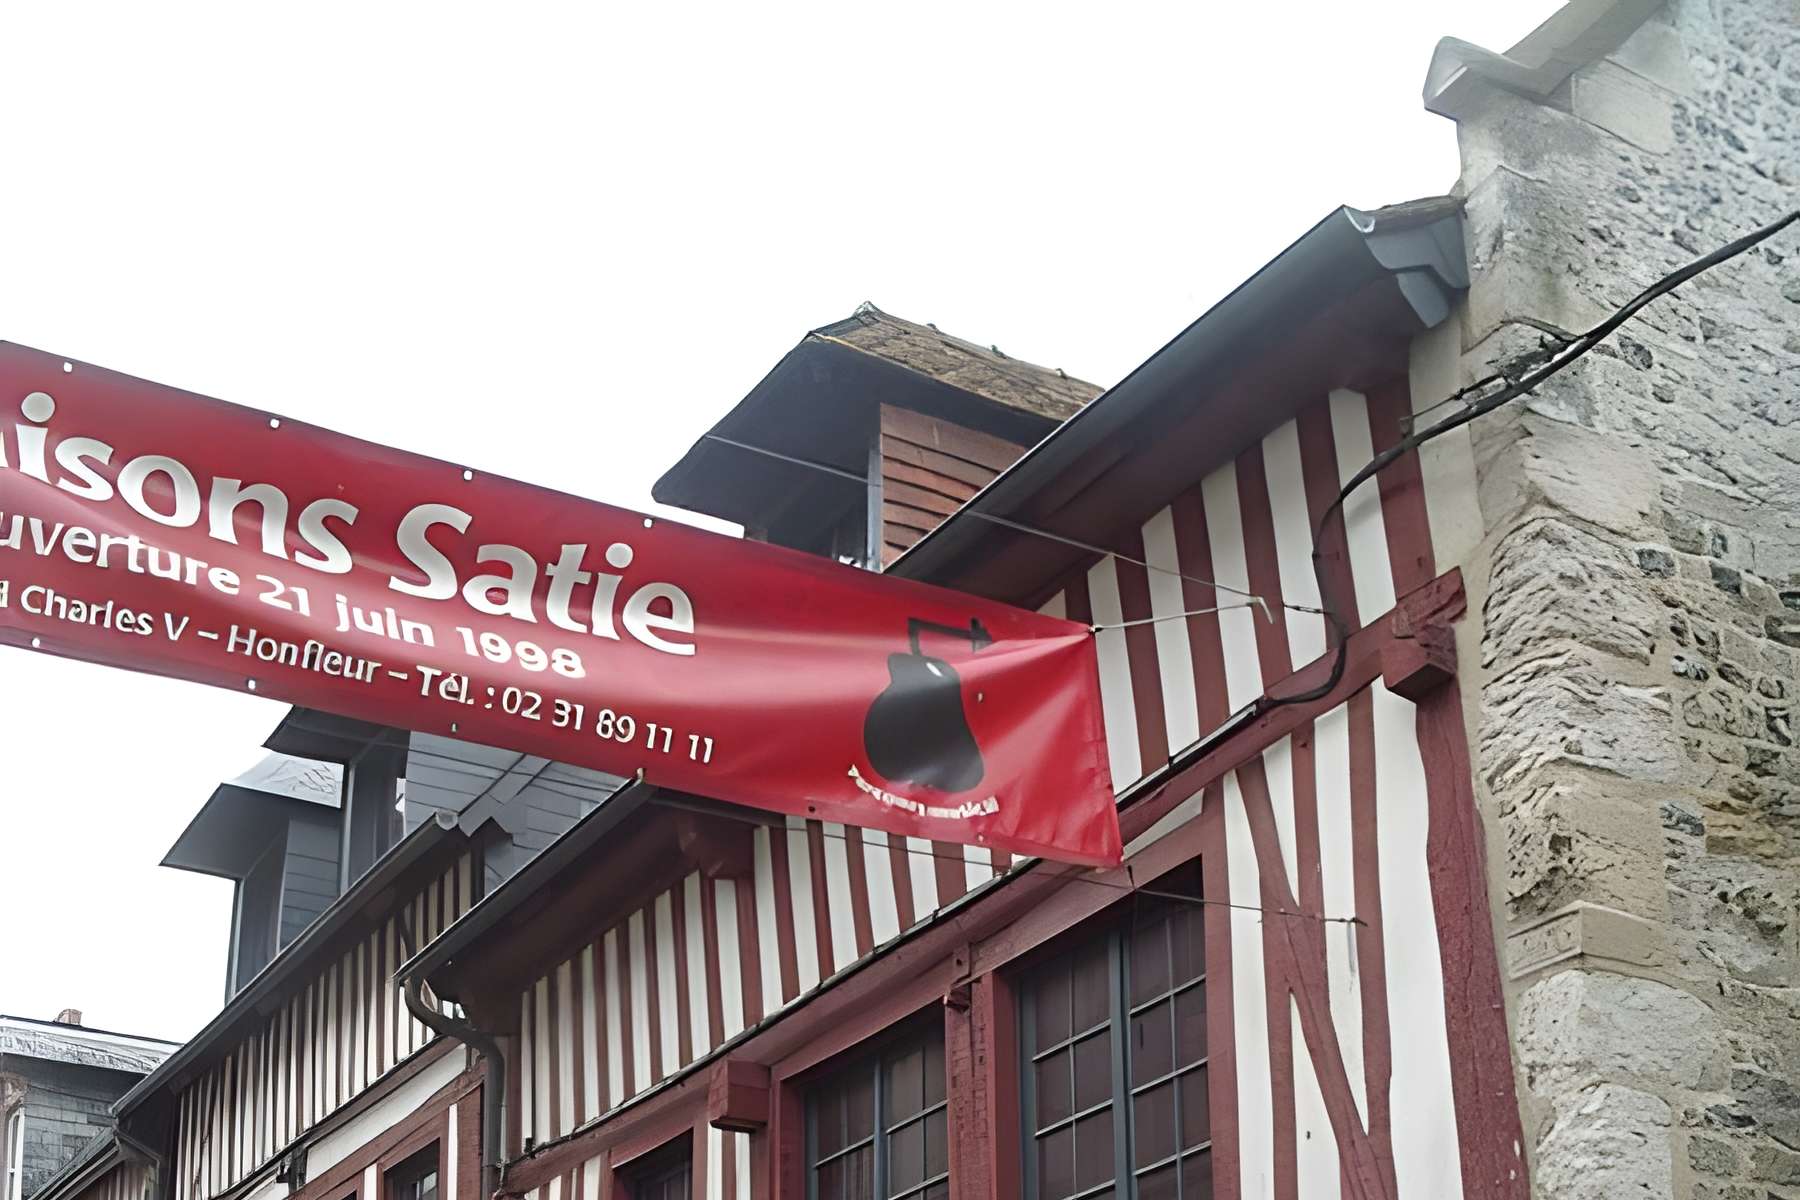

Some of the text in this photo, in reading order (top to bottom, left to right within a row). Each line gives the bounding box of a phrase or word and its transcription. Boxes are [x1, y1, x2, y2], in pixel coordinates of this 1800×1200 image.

[0, 391, 696, 656] isons Satie
[20, 585, 154, 636] Charles
[164, 612, 190, 641] V
[226, 625, 382, 684] Honfleur
[502, 686, 542, 721] 02
[552, 699, 584, 731] 31
[596, 708, 636, 744] 89
[646, 723, 673, 753] 11
[688, 734, 713, 764] 11
[255, 574, 312, 618] 21
[335, 593, 435, 648] juin
[456, 626, 587, 679] 1998
